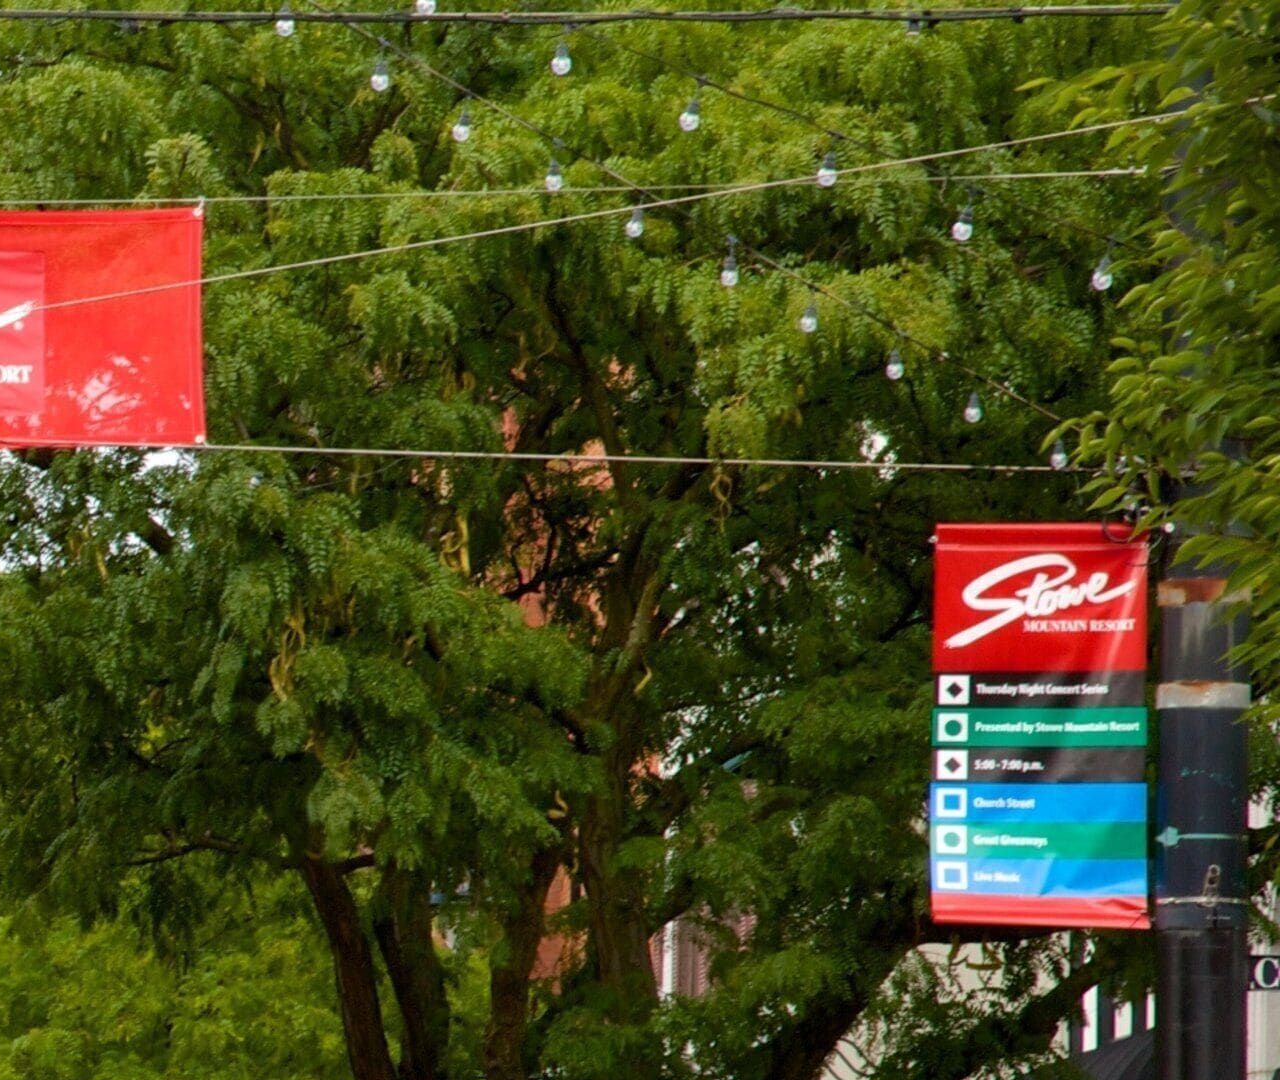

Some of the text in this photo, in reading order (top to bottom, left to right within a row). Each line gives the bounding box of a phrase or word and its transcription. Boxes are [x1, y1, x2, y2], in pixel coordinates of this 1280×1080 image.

[944, 553, 1137, 649] Stowe
[1023, 619, 1136, 632] MOUNTAIN RESORT
[976, 683, 1109, 697] Thursday Night Concert Series
[975, 721, 1140, 734] Presented by Stowe Mountain Resort
[974, 759, 996, 771] 5:00
[1001, 759, 1022, 771] 7:00
[1022, 762, 1044, 773] p.m.
[973, 797, 1035, 809] Church Street
[972, 834, 1048, 848] Great Giveaways
[973, 872, 1020, 883] Live Music
